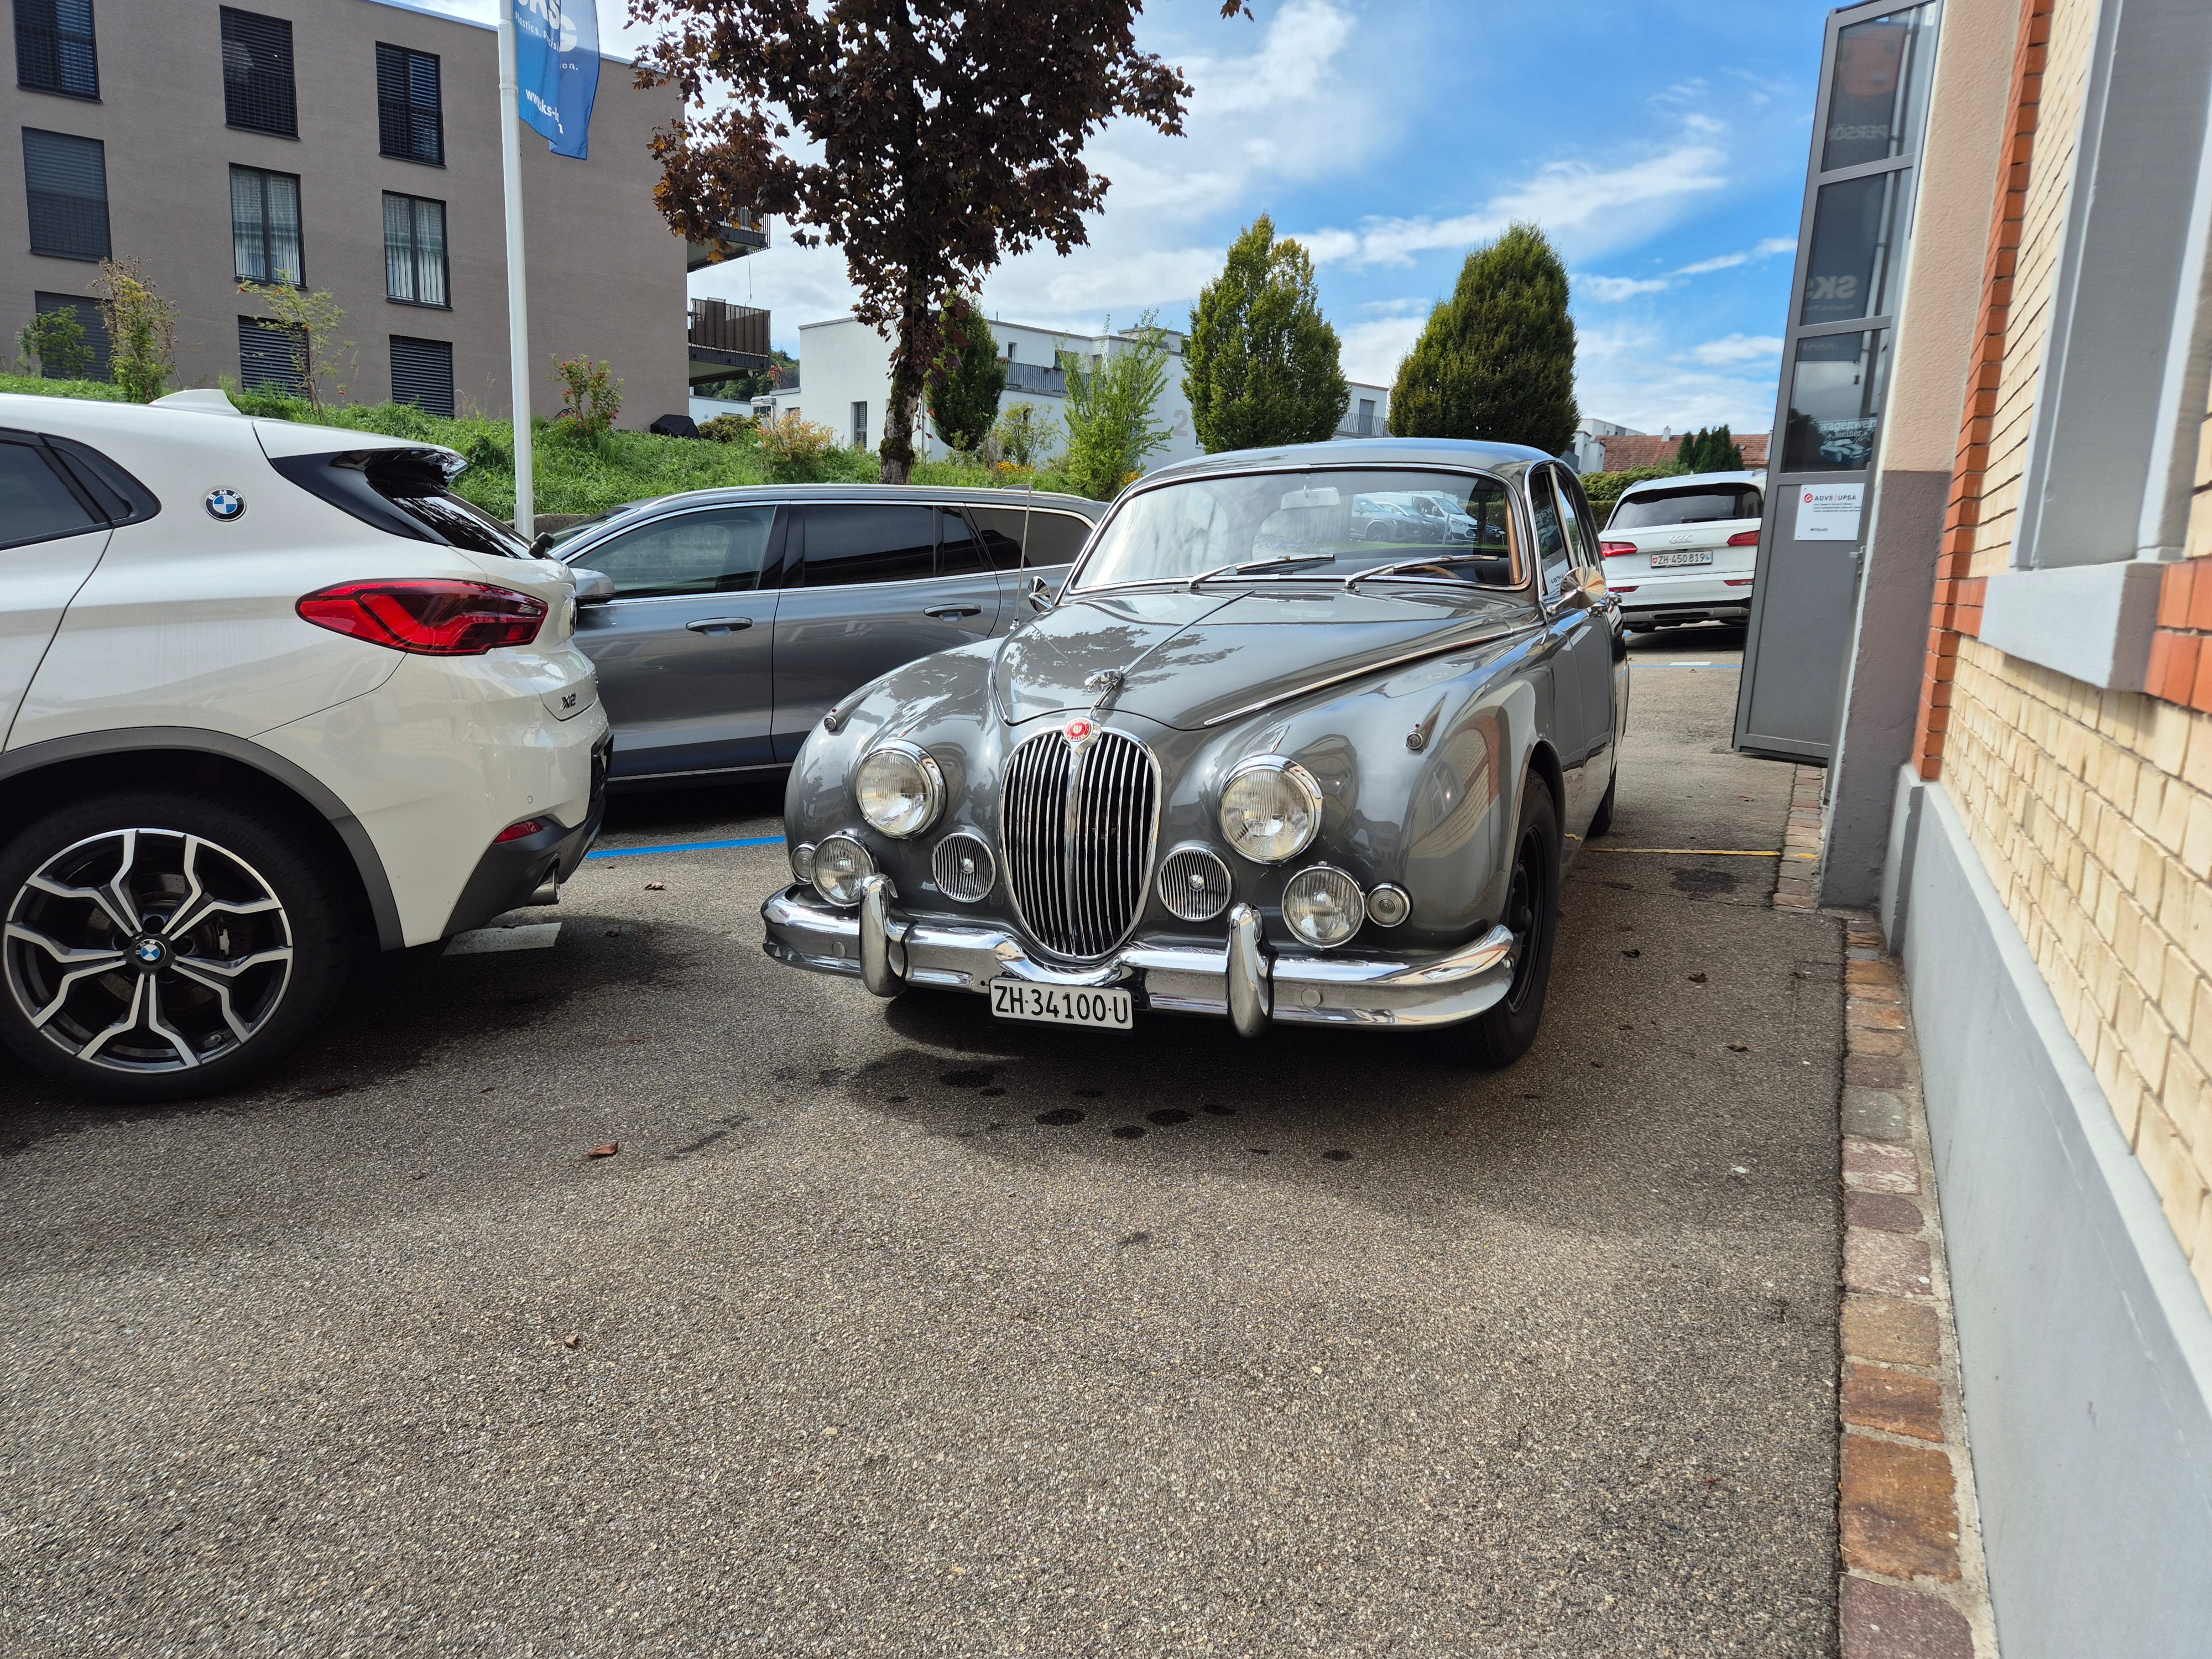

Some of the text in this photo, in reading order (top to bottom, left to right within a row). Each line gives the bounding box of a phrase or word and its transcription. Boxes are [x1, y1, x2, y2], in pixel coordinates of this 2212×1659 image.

[208, 489, 241, 500] BMW
[559, 692, 576, 711] X2
[135, 940, 156, 955] BMW
